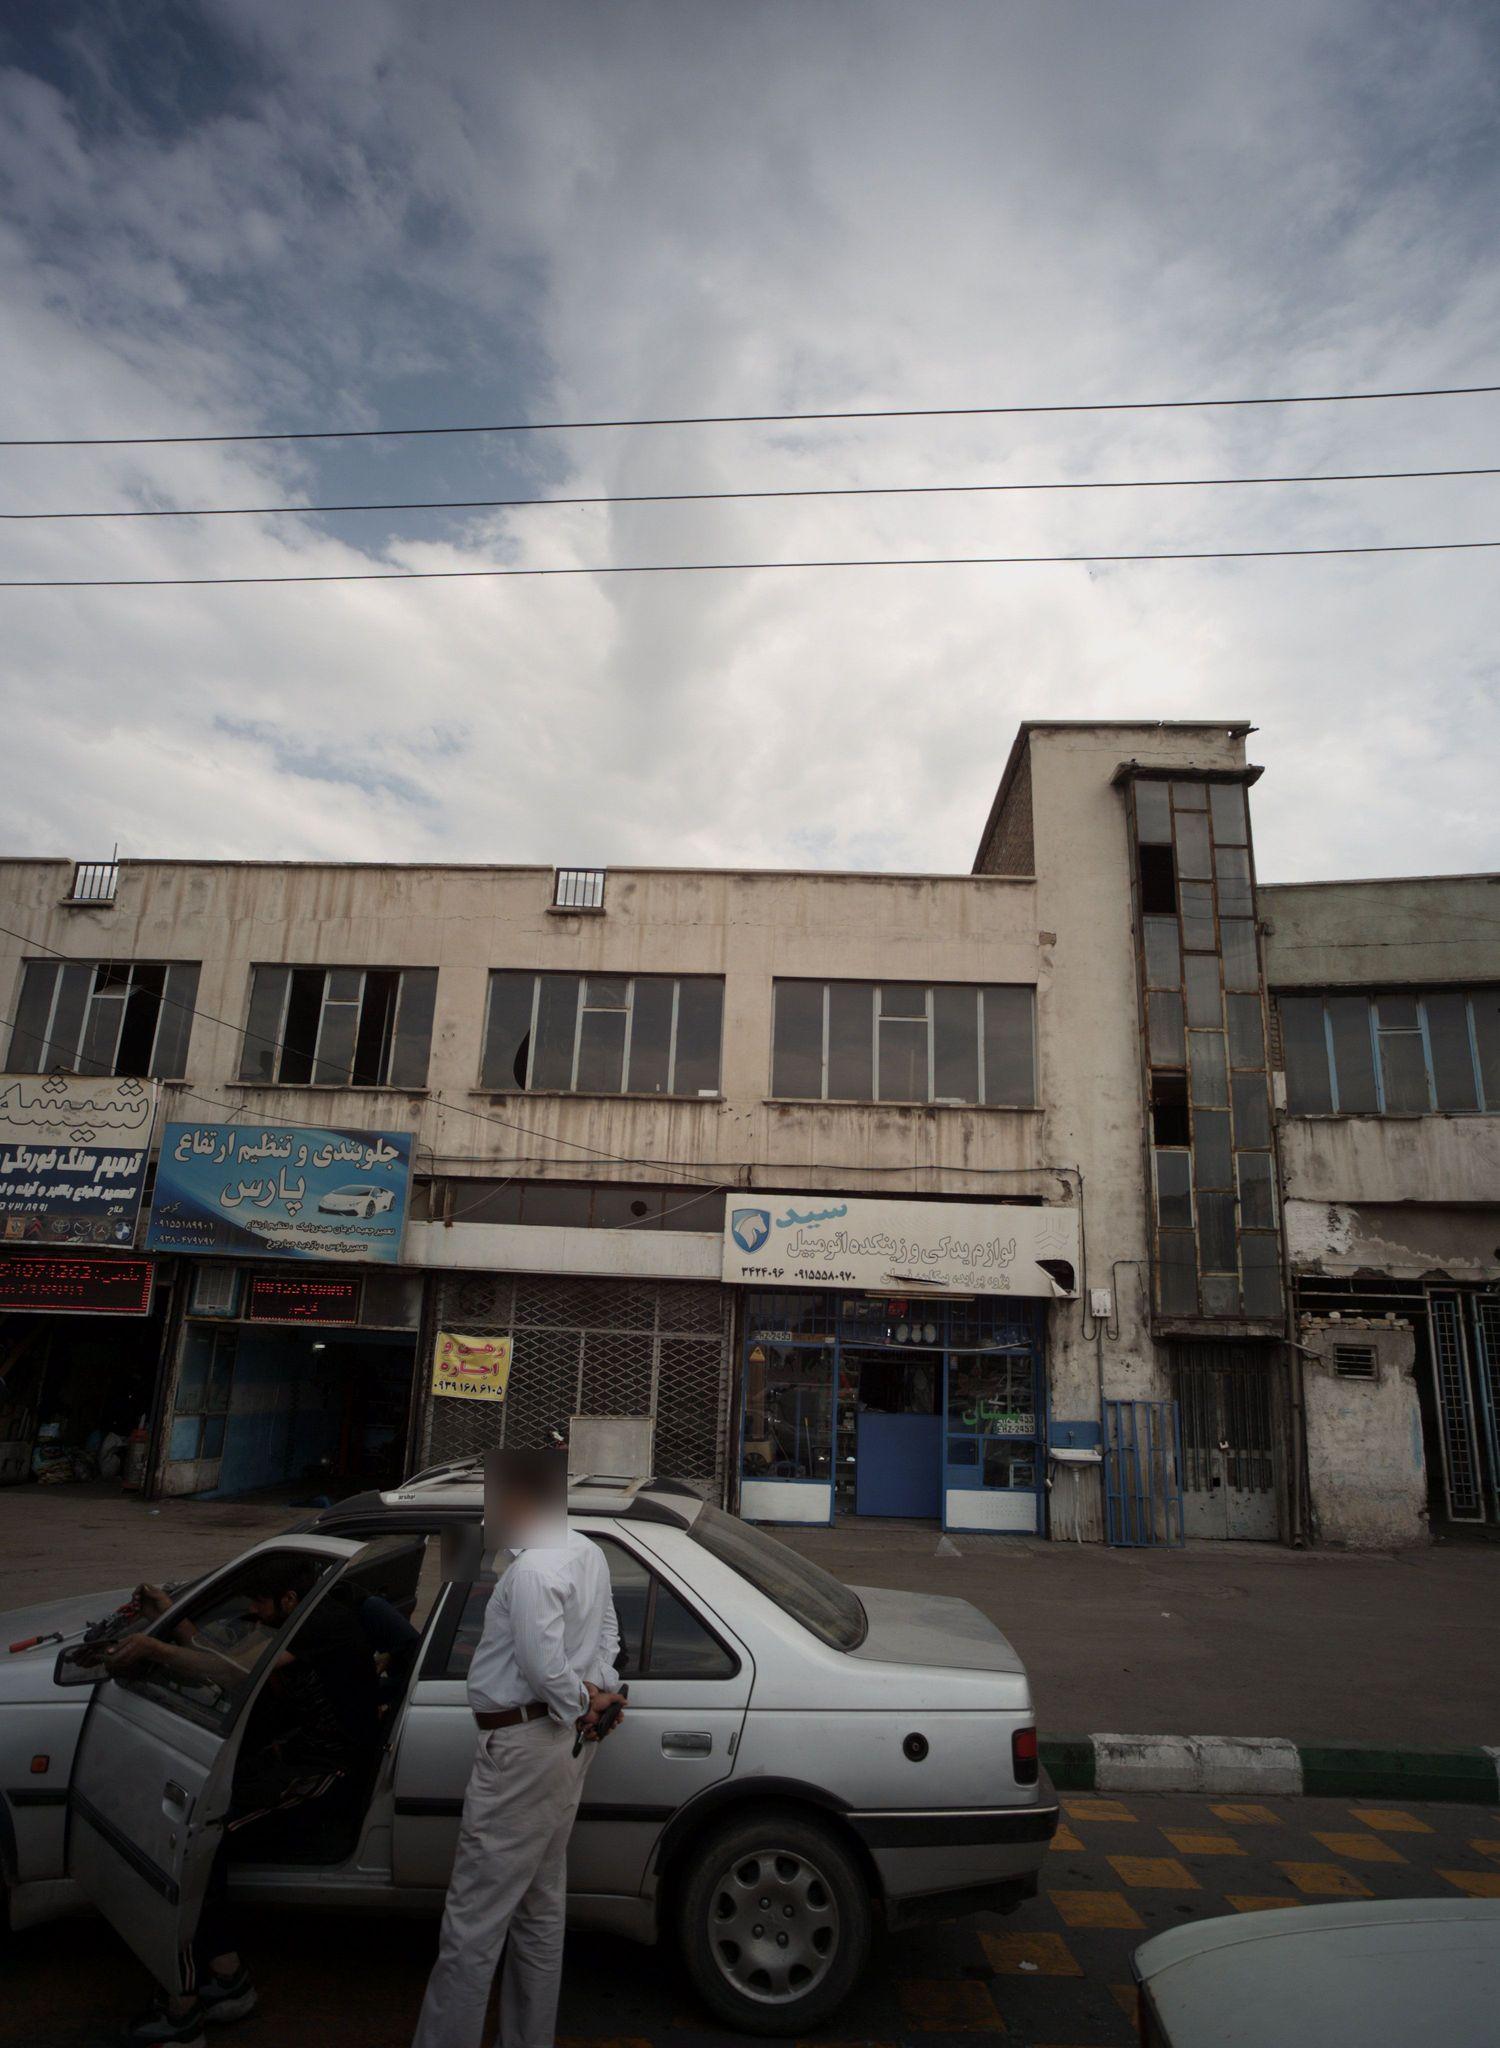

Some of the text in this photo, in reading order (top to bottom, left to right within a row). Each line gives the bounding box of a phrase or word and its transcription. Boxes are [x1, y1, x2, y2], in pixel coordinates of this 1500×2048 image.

[57, 1148, 97, 1171] سنگ
[174, 1129, 399, 1170] جلوبندی و تنظیم ارتفاع
[93, 1152, 143, 1182] ترمیم
[219, 1165, 306, 1217] پارس
[787, 1229, 848, 1260] اتومبیل
[908, 1243, 920, 1264] و
[921, 1235, 970, 1265] یدکی
[971, 1237, 1017, 1268] لوازم
[794, 1269, 856, 1280] ۰۹۱۵۵۵۸۰۹۷۰
[442, 1341, 453, 1355] و
[440, 1360, 499, 1379] اجاره
[460, 1384, 477, 1393] ۱۶۸
[480, 1385, 503, 1395] ۶۱۰۵
